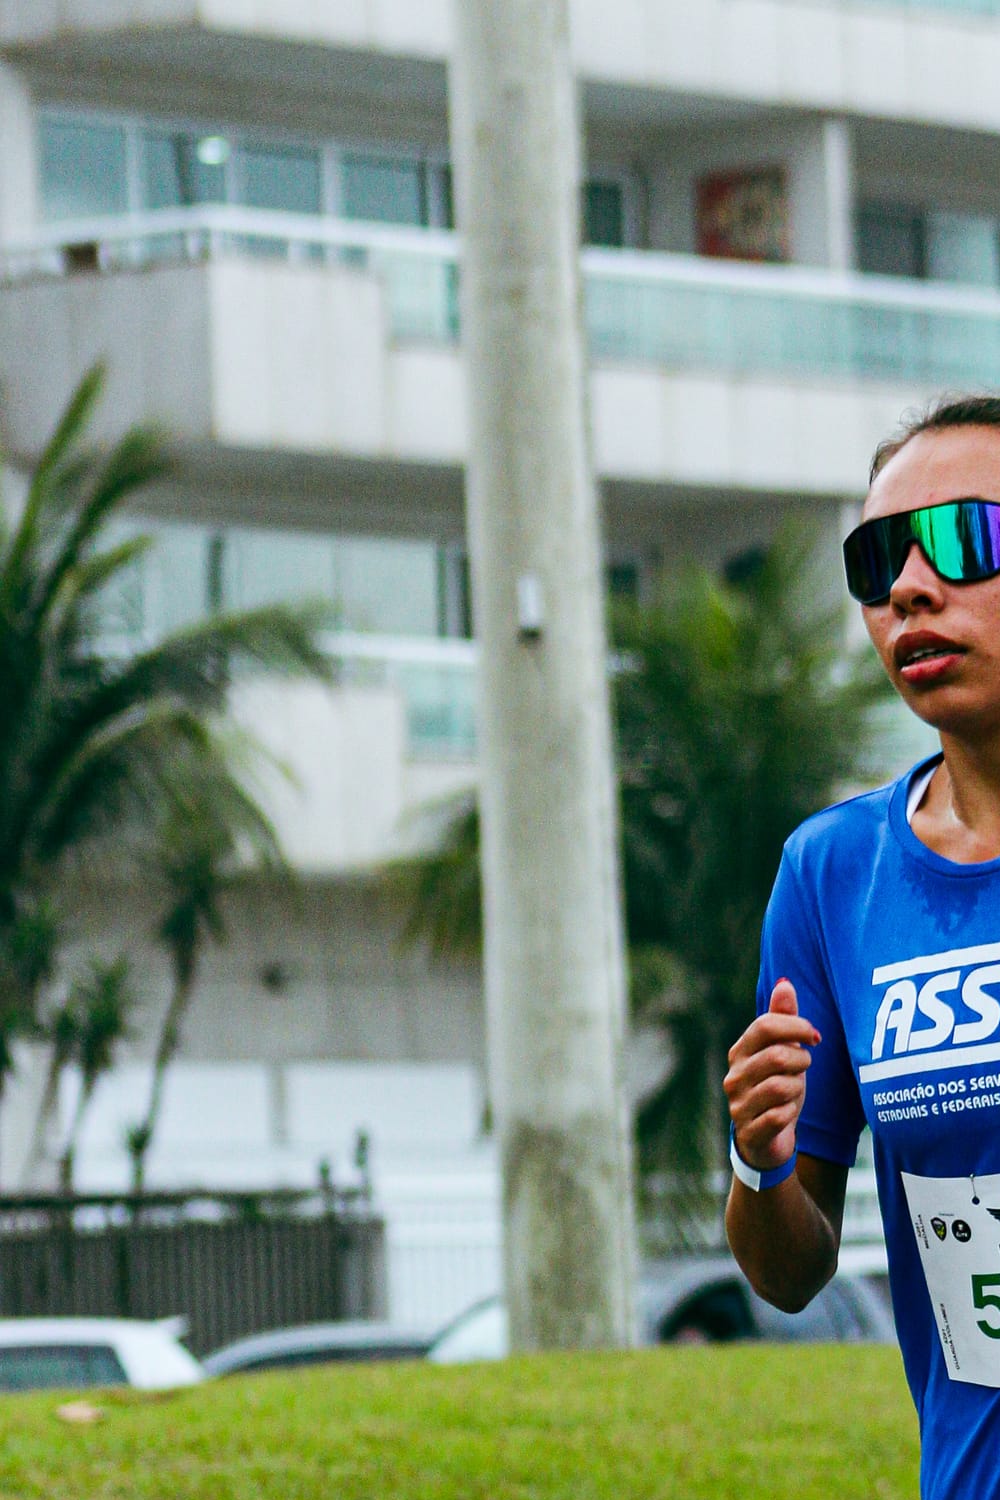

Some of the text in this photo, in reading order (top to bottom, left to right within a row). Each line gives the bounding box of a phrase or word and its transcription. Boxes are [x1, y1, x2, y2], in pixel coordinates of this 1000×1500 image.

[873, 1083, 935, 1106] ASSOCIAÇÃO
[939, 1082, 966, 1097] DOS
[877, 1106, 928, 1122] ESTADUAIS
[931, 1105, 939, 1115] E
